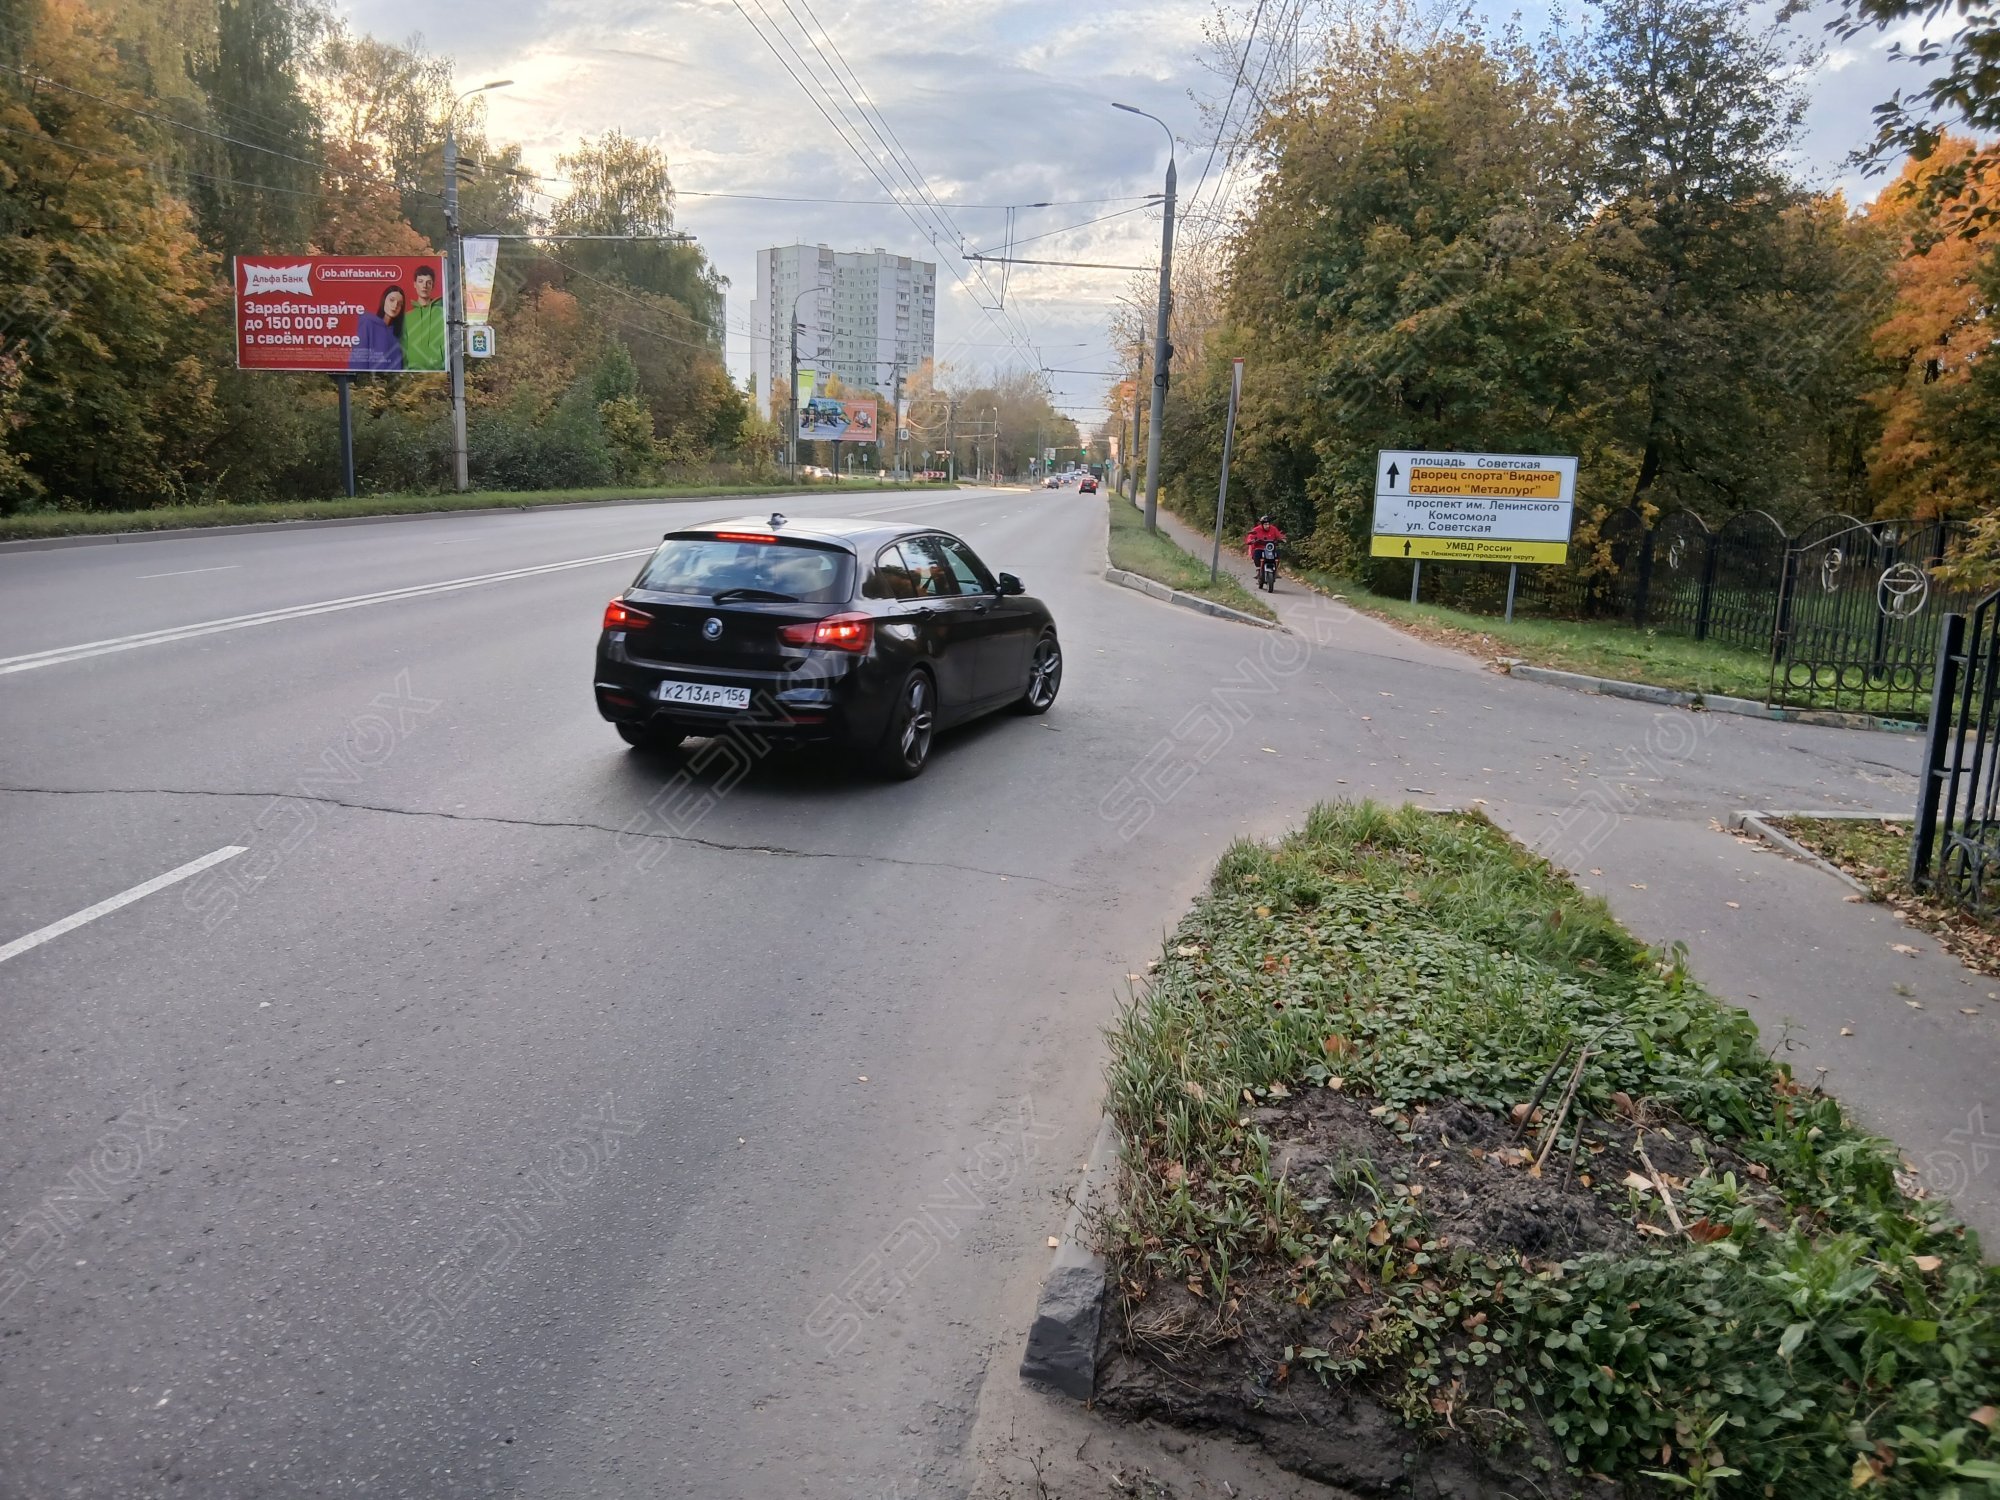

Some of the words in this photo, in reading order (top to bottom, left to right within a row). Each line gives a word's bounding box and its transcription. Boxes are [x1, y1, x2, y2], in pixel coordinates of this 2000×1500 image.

[320, 268, 396, 279] job.alfabank.ru
[252, 274, 281, 286] Альфа
[282, 274, 304, 283] Банк
[244, 301, 365, 316] Зарабатывайте
[244, 318, 263, 331] до
[266, 316, 290, 330] 150
[294, 316, 323, 330] 000
[245, 334, 254, 345] в
[257, 331, 304, 345] своём
[307, 334, 361, 348] городе
[1410, 457, 1466, 467] площадь
[1477, 457, 1541, 469] Советская
[1410, 469, 1458, 481] Дворец
[1460, 471, 1503, 482] спорта
[1410, 484, 1461, 494] стадион
[1465, 485, 1541, 497] "Металлург"
[1407, 500, 1462, 510] проспект
[1465, 501, 1486, 510] им.
[1489, 501, 1560, 512] Ленинского
[1428, 510, 1497, 522] Комсомола
[1406, 522, 1424, 532] ул.
[1428, 521, 1492, 533] Советская
[1446, 541, 1474, 551] УМВД
[1477, 544, 1512, 552] России
[1431, 550, 1471, 558] Ленинскому
[724, 689, 746, 702] 156
